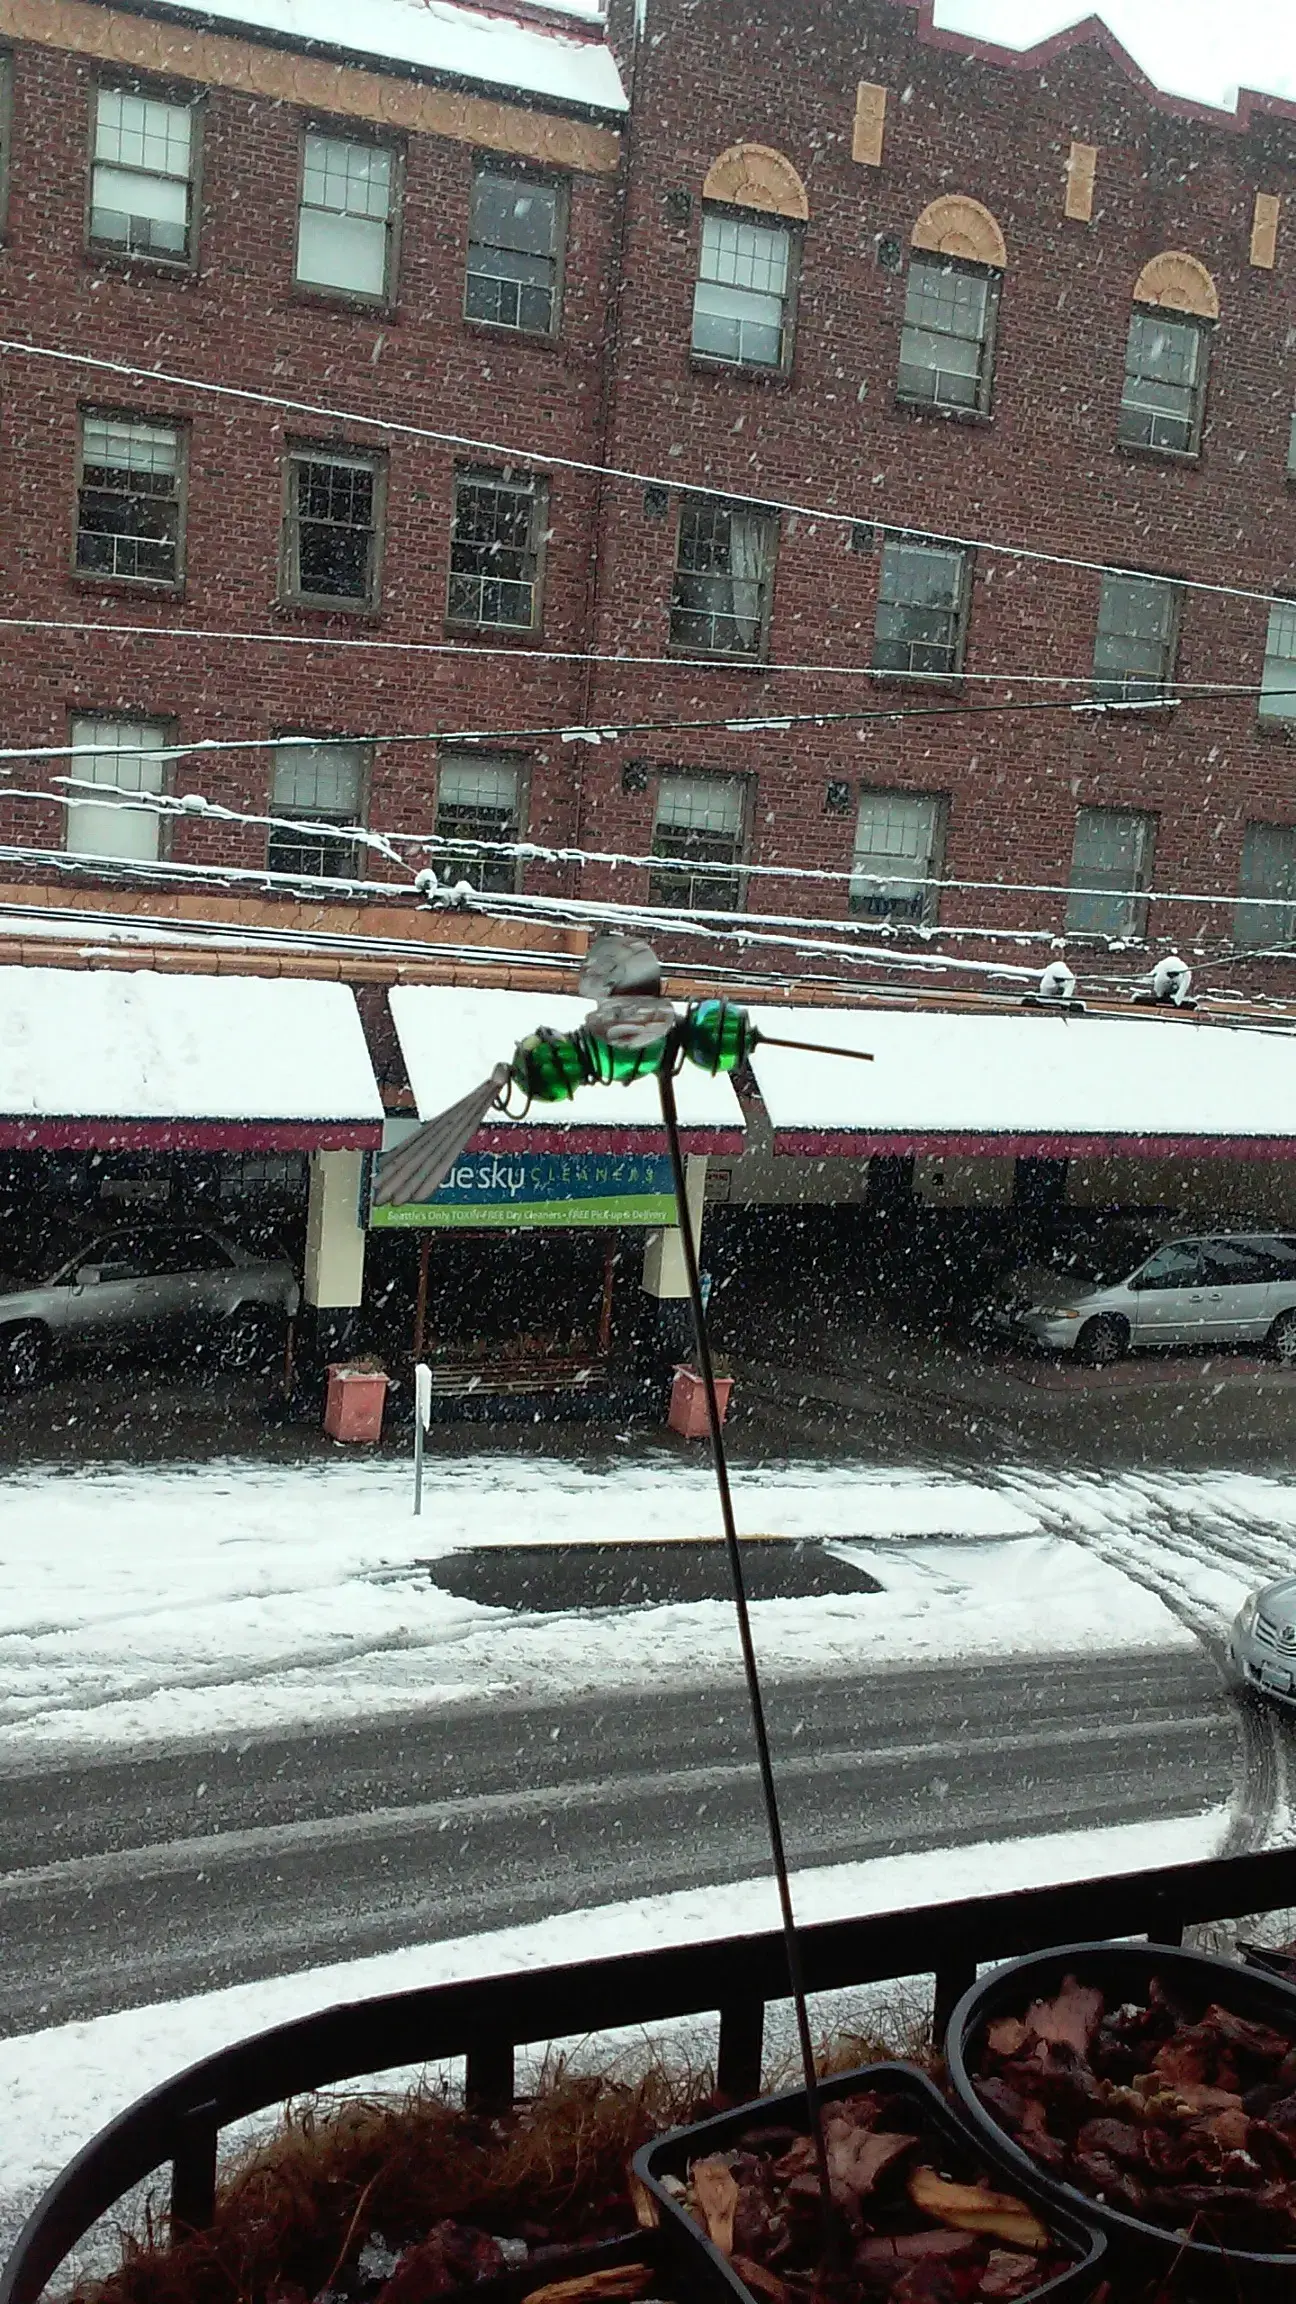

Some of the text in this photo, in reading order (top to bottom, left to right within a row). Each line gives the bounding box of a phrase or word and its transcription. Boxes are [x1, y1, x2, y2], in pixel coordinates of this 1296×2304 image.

[477, 1160, 525, 1197] sky
[531, 1166, 654, 1183] CLEANERS
[387, 1210, 426, 1221] Seattle's
[428, 1210, 450, 1222] Only
[506, 1210, 522, 1222] Dry
[523, 1210, 561, 1220] Cleaners
[632, 1209, 667, 1221] Delivery
